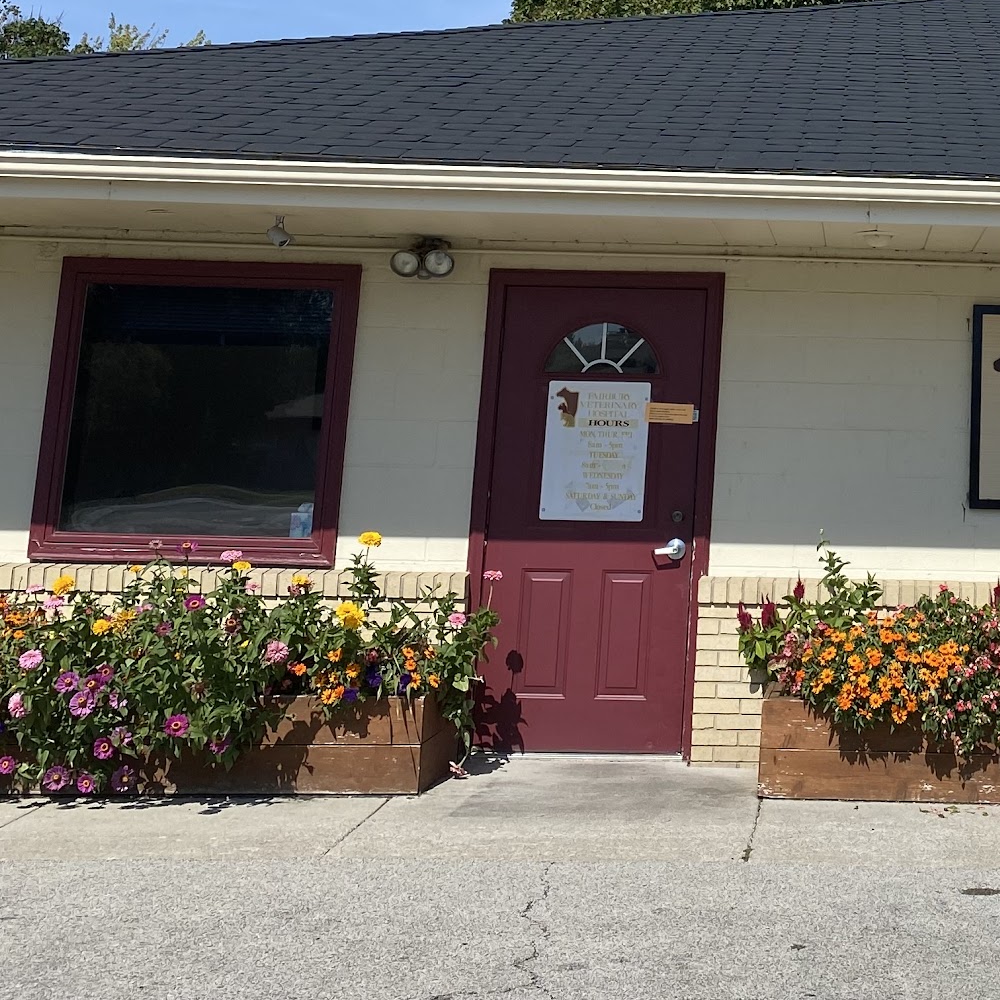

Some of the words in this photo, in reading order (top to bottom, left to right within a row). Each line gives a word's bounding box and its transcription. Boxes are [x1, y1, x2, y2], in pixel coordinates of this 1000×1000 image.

[588, 392, 630, 400] FAIRBURY
[580, 401, 638, 409] VETERINARY
[588, 410, 630, 418] HOSPITAL
[588, 419, 630, 427] HOURS
[589, 451, 618, 459] TUESDAY
[582, 471, 624, 480] WEDNESDAY
[565, 492, 601, 500] SATURDAY
[610, 493, 636, 501] SUNDAY
